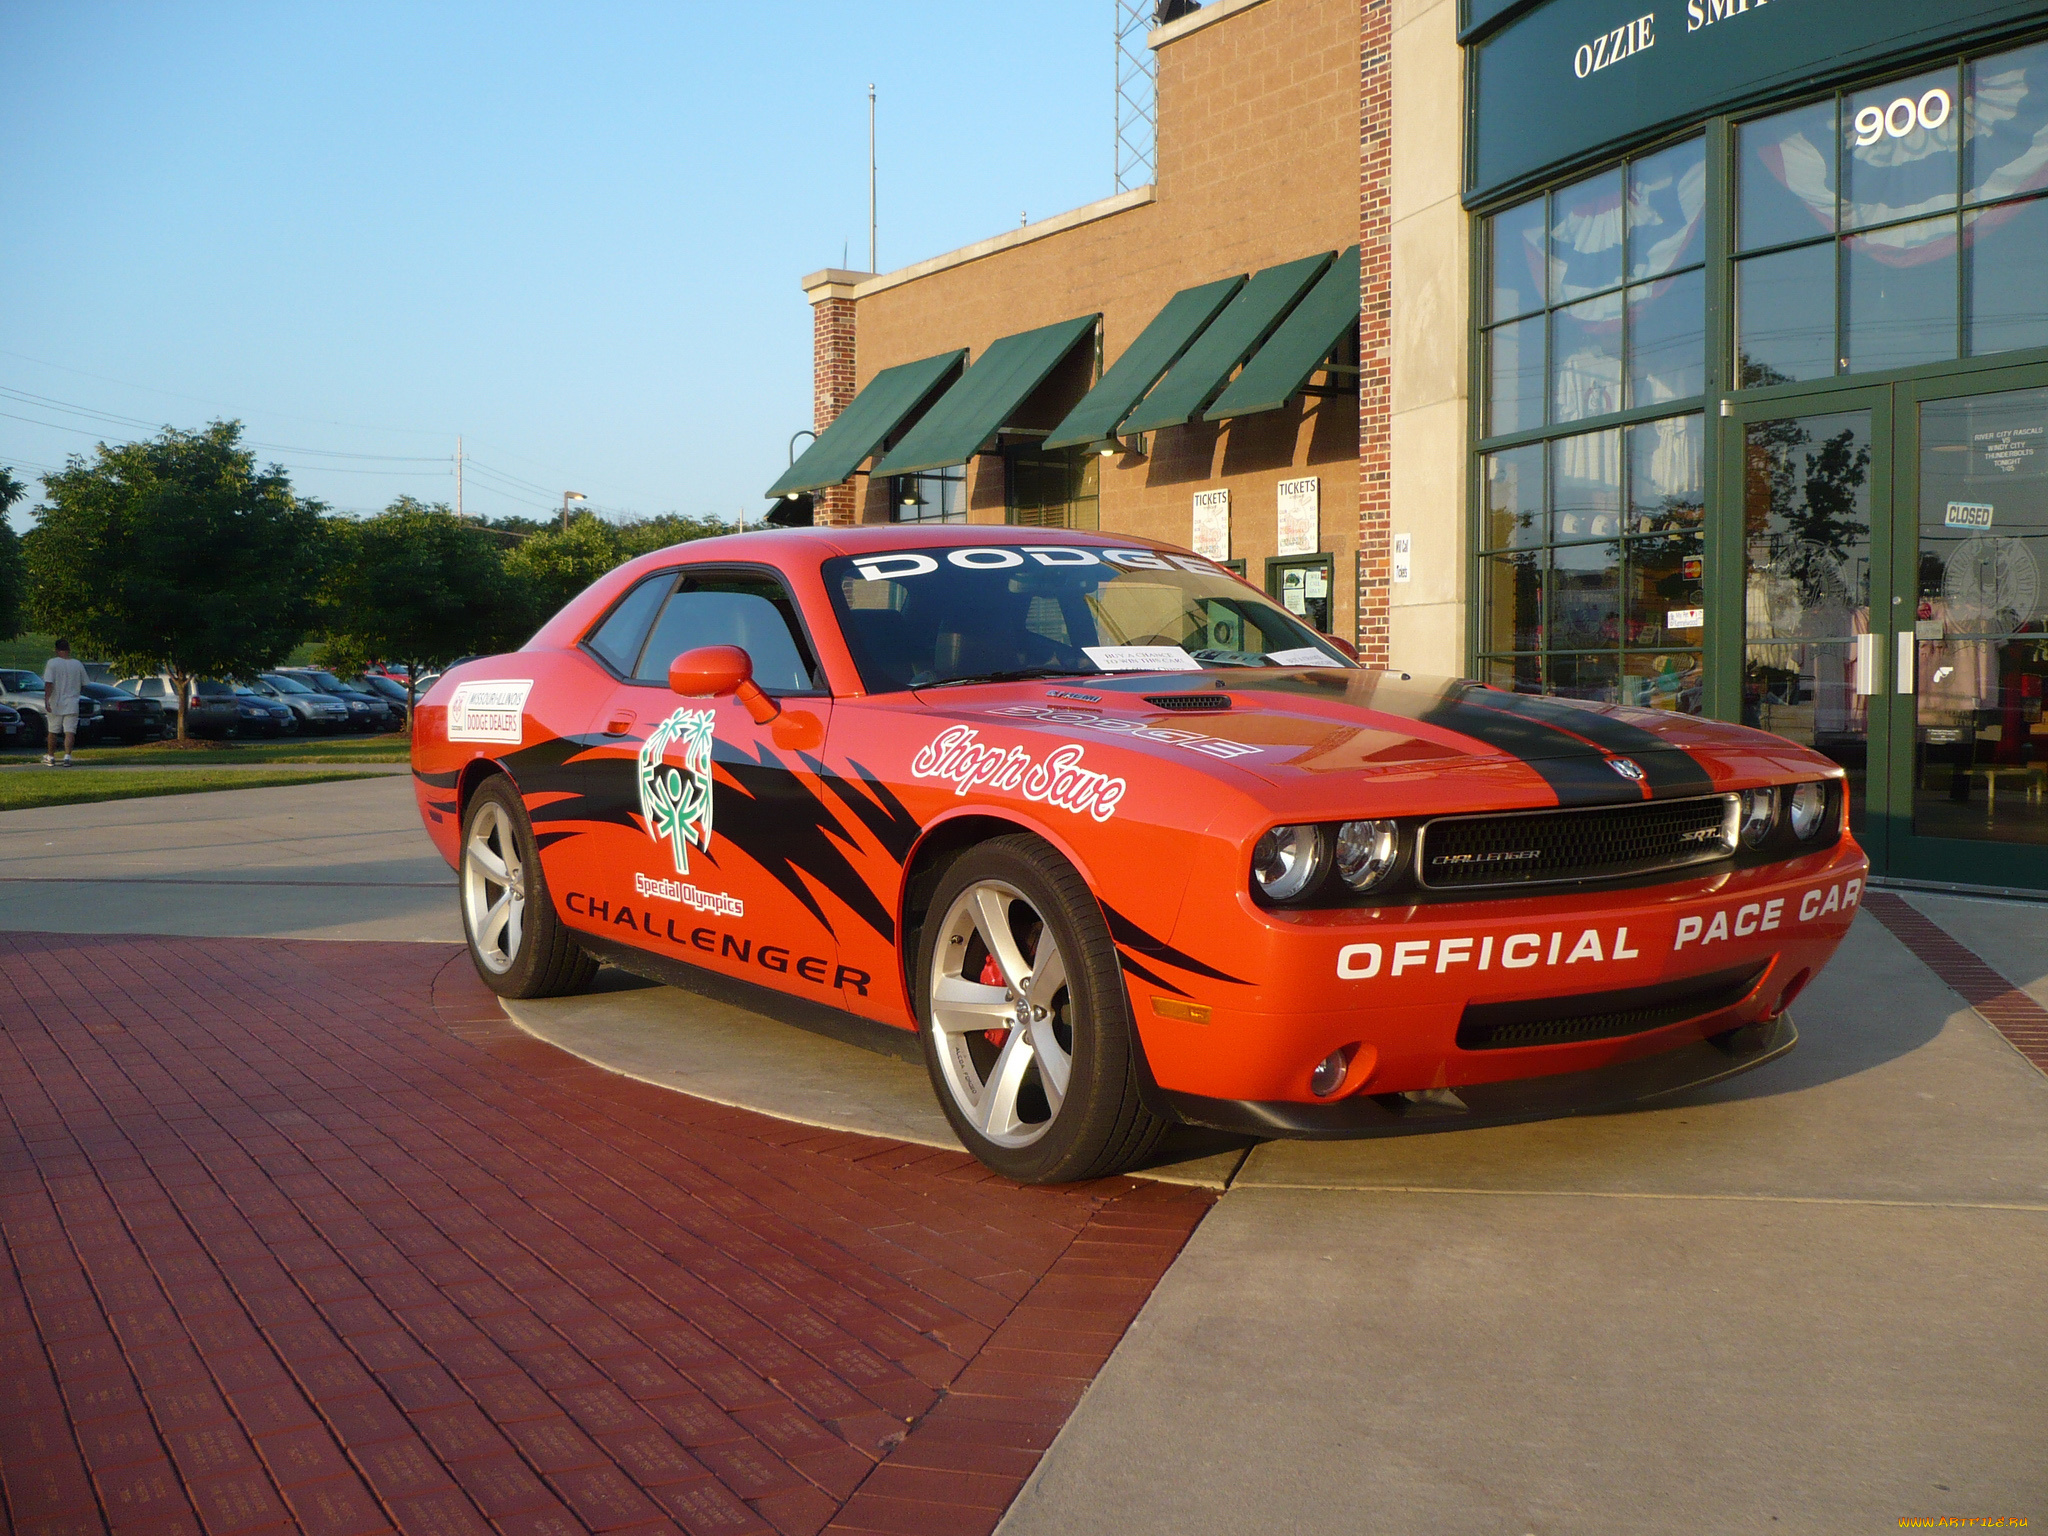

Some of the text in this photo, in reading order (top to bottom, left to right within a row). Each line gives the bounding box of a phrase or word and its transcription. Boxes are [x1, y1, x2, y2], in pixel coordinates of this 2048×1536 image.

[1574, 13, 1656, 79] OZZIE
[1854, 88, 1950, 147] 900
[1974, 427, 2044, 441] RIVER CITY RASCALS
[1985, 449, 2034, 460] THUNDERBOLTS
[1987, 443, 2008, 452] WINDY
[1993, 458, 2022, 467] TONIGHT
[1279, 479, 1316, 496] TICKETS
[1194, 491, 1227, 507] TICKETS
[1948, 505, 1991, 526] CLOSED
[852, 547, 1233, 582] DODGE
[469, 692, 524, 706] MISSOURI-ILLINOIS
[467, 714, 517, 732] DODGE DEALERS
[984, 705, 1265, 760] DODGE
[1022, 744, 1126, 822] Save
[1432, 850, 1542, 865] CHALLENGER
[636, 873, 743, 915] Special Olympics
[1673, 878, 1862, 951] PACE CAR
[566, 892, 872, 997] CHALLENGER
[1336, 927, 1639, 980] OFFICIAL
